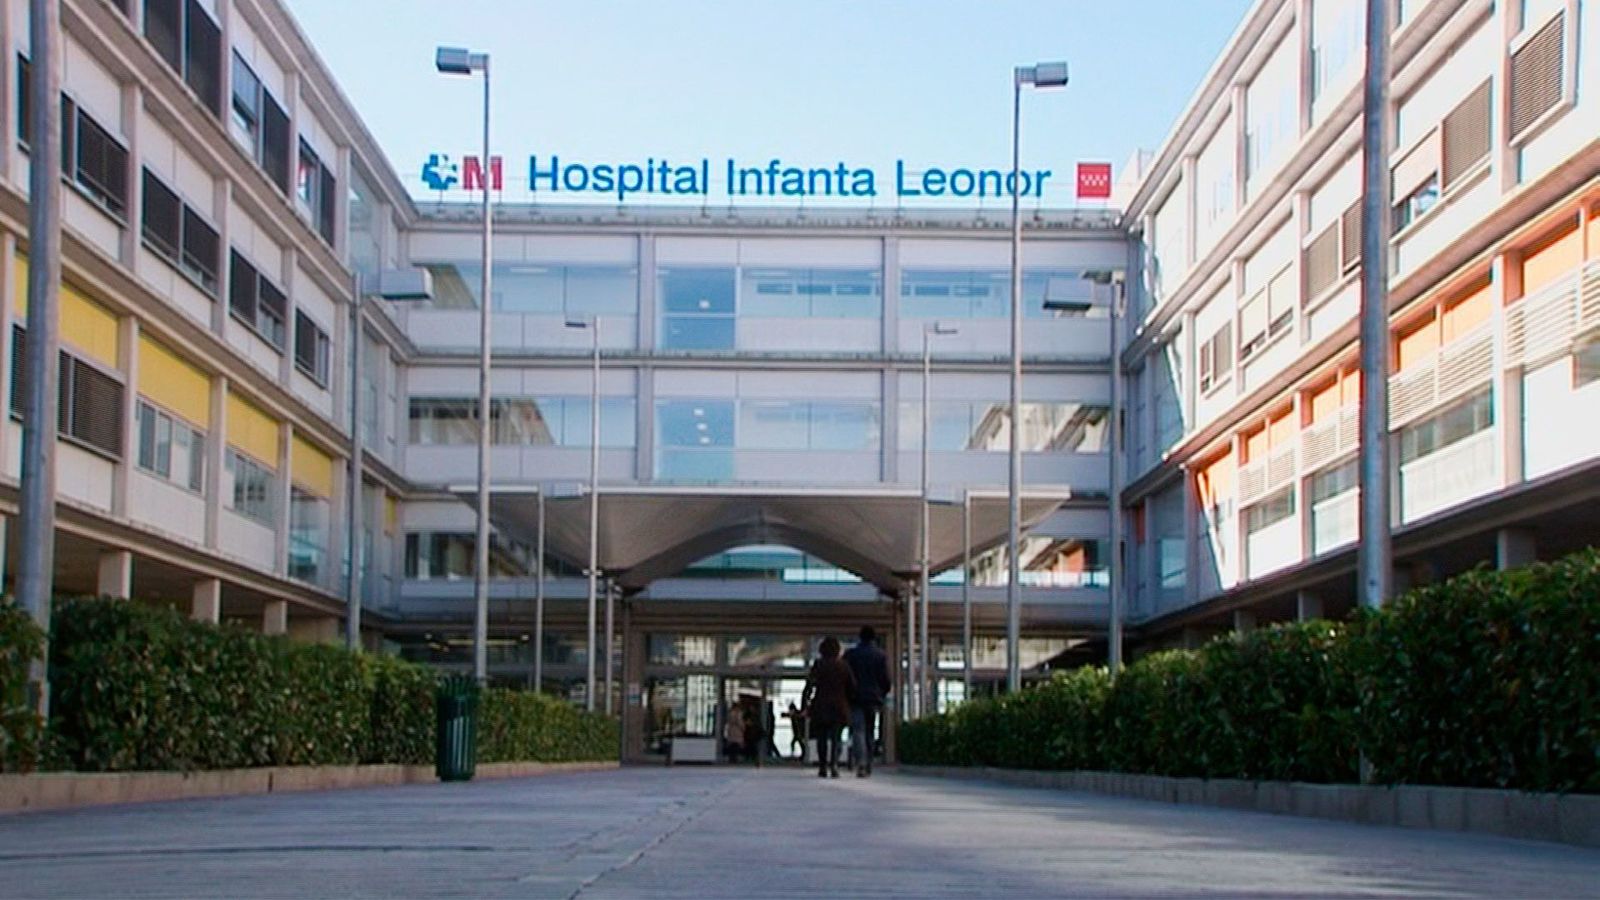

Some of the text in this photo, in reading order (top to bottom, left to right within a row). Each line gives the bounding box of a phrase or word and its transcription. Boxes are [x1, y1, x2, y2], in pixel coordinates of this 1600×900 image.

[528, 155, 709, 202] Hospital
[727, 158, 877, 197] Infanta
[896, 159, 1053, 198] Leonor
